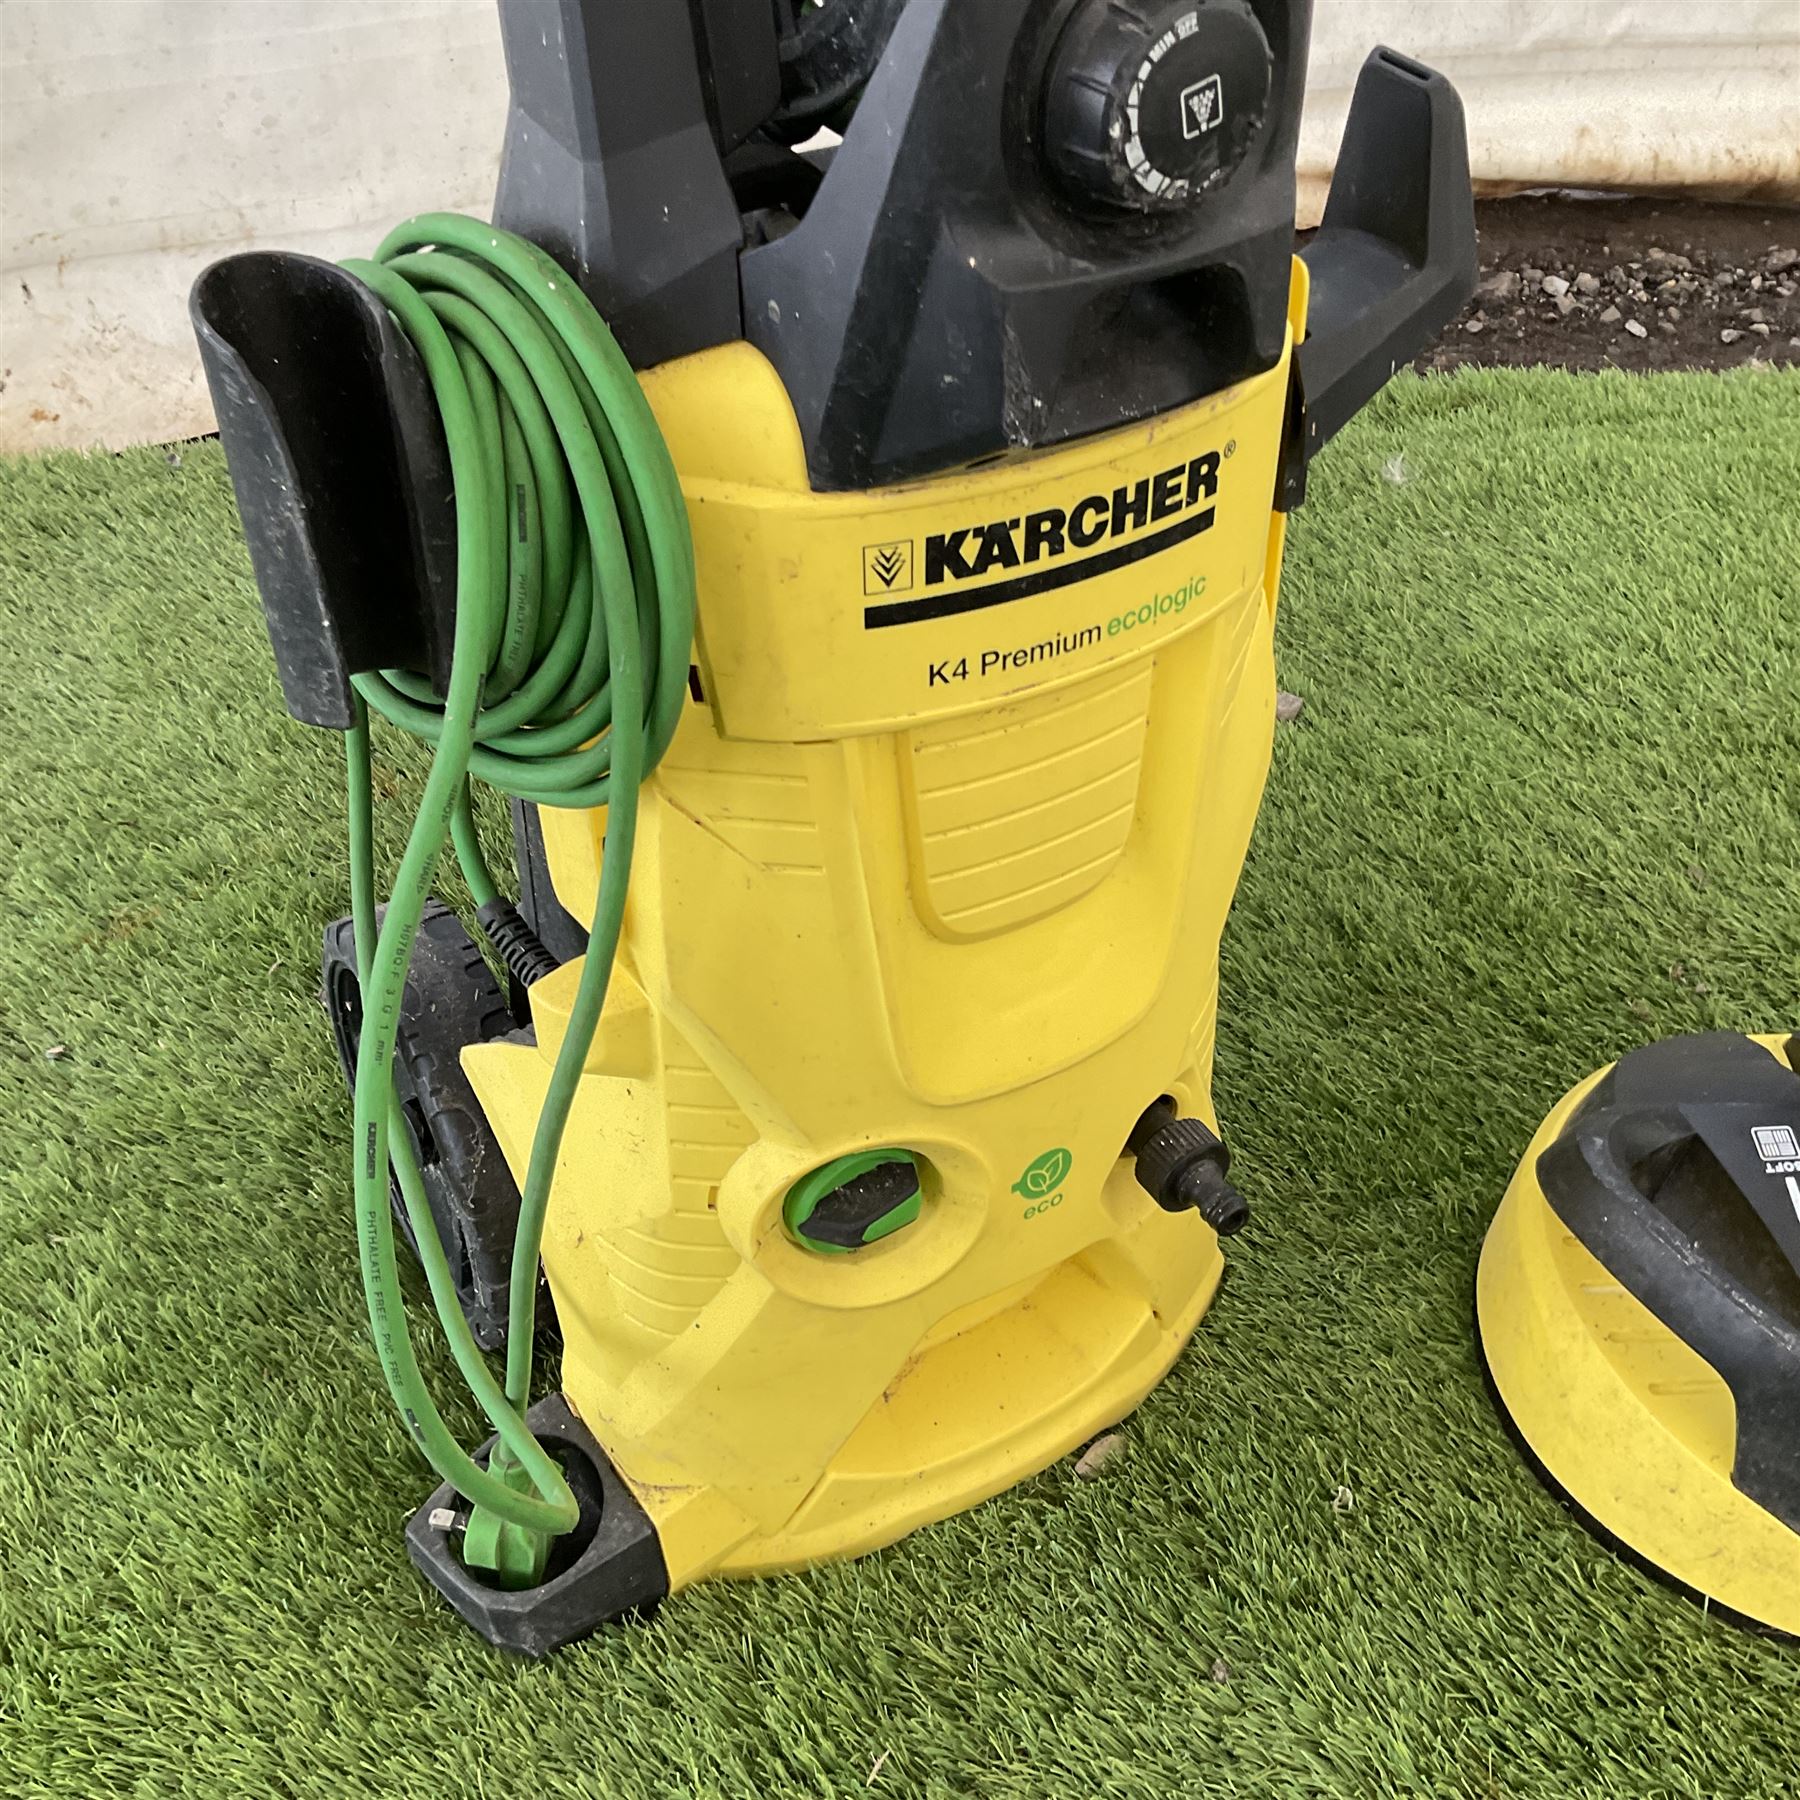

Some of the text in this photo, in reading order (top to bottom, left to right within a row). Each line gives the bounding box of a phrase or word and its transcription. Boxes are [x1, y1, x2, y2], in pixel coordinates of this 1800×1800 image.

[925, 451, 1221, 586] KÄRCHER
[929, 659, 969, 686] K4
[980, 625, 1102, 676] Premium
[382, 1004, 393, 1015] G
[385, 988, 394, 996] 3
[1023, 1193, 1064, 1220] eco
[368, 1211, 382, 1284] PHTHALATE
[375, 1290, 388, 1321] FREE
[382, 1333, 394, 1356] PVC
